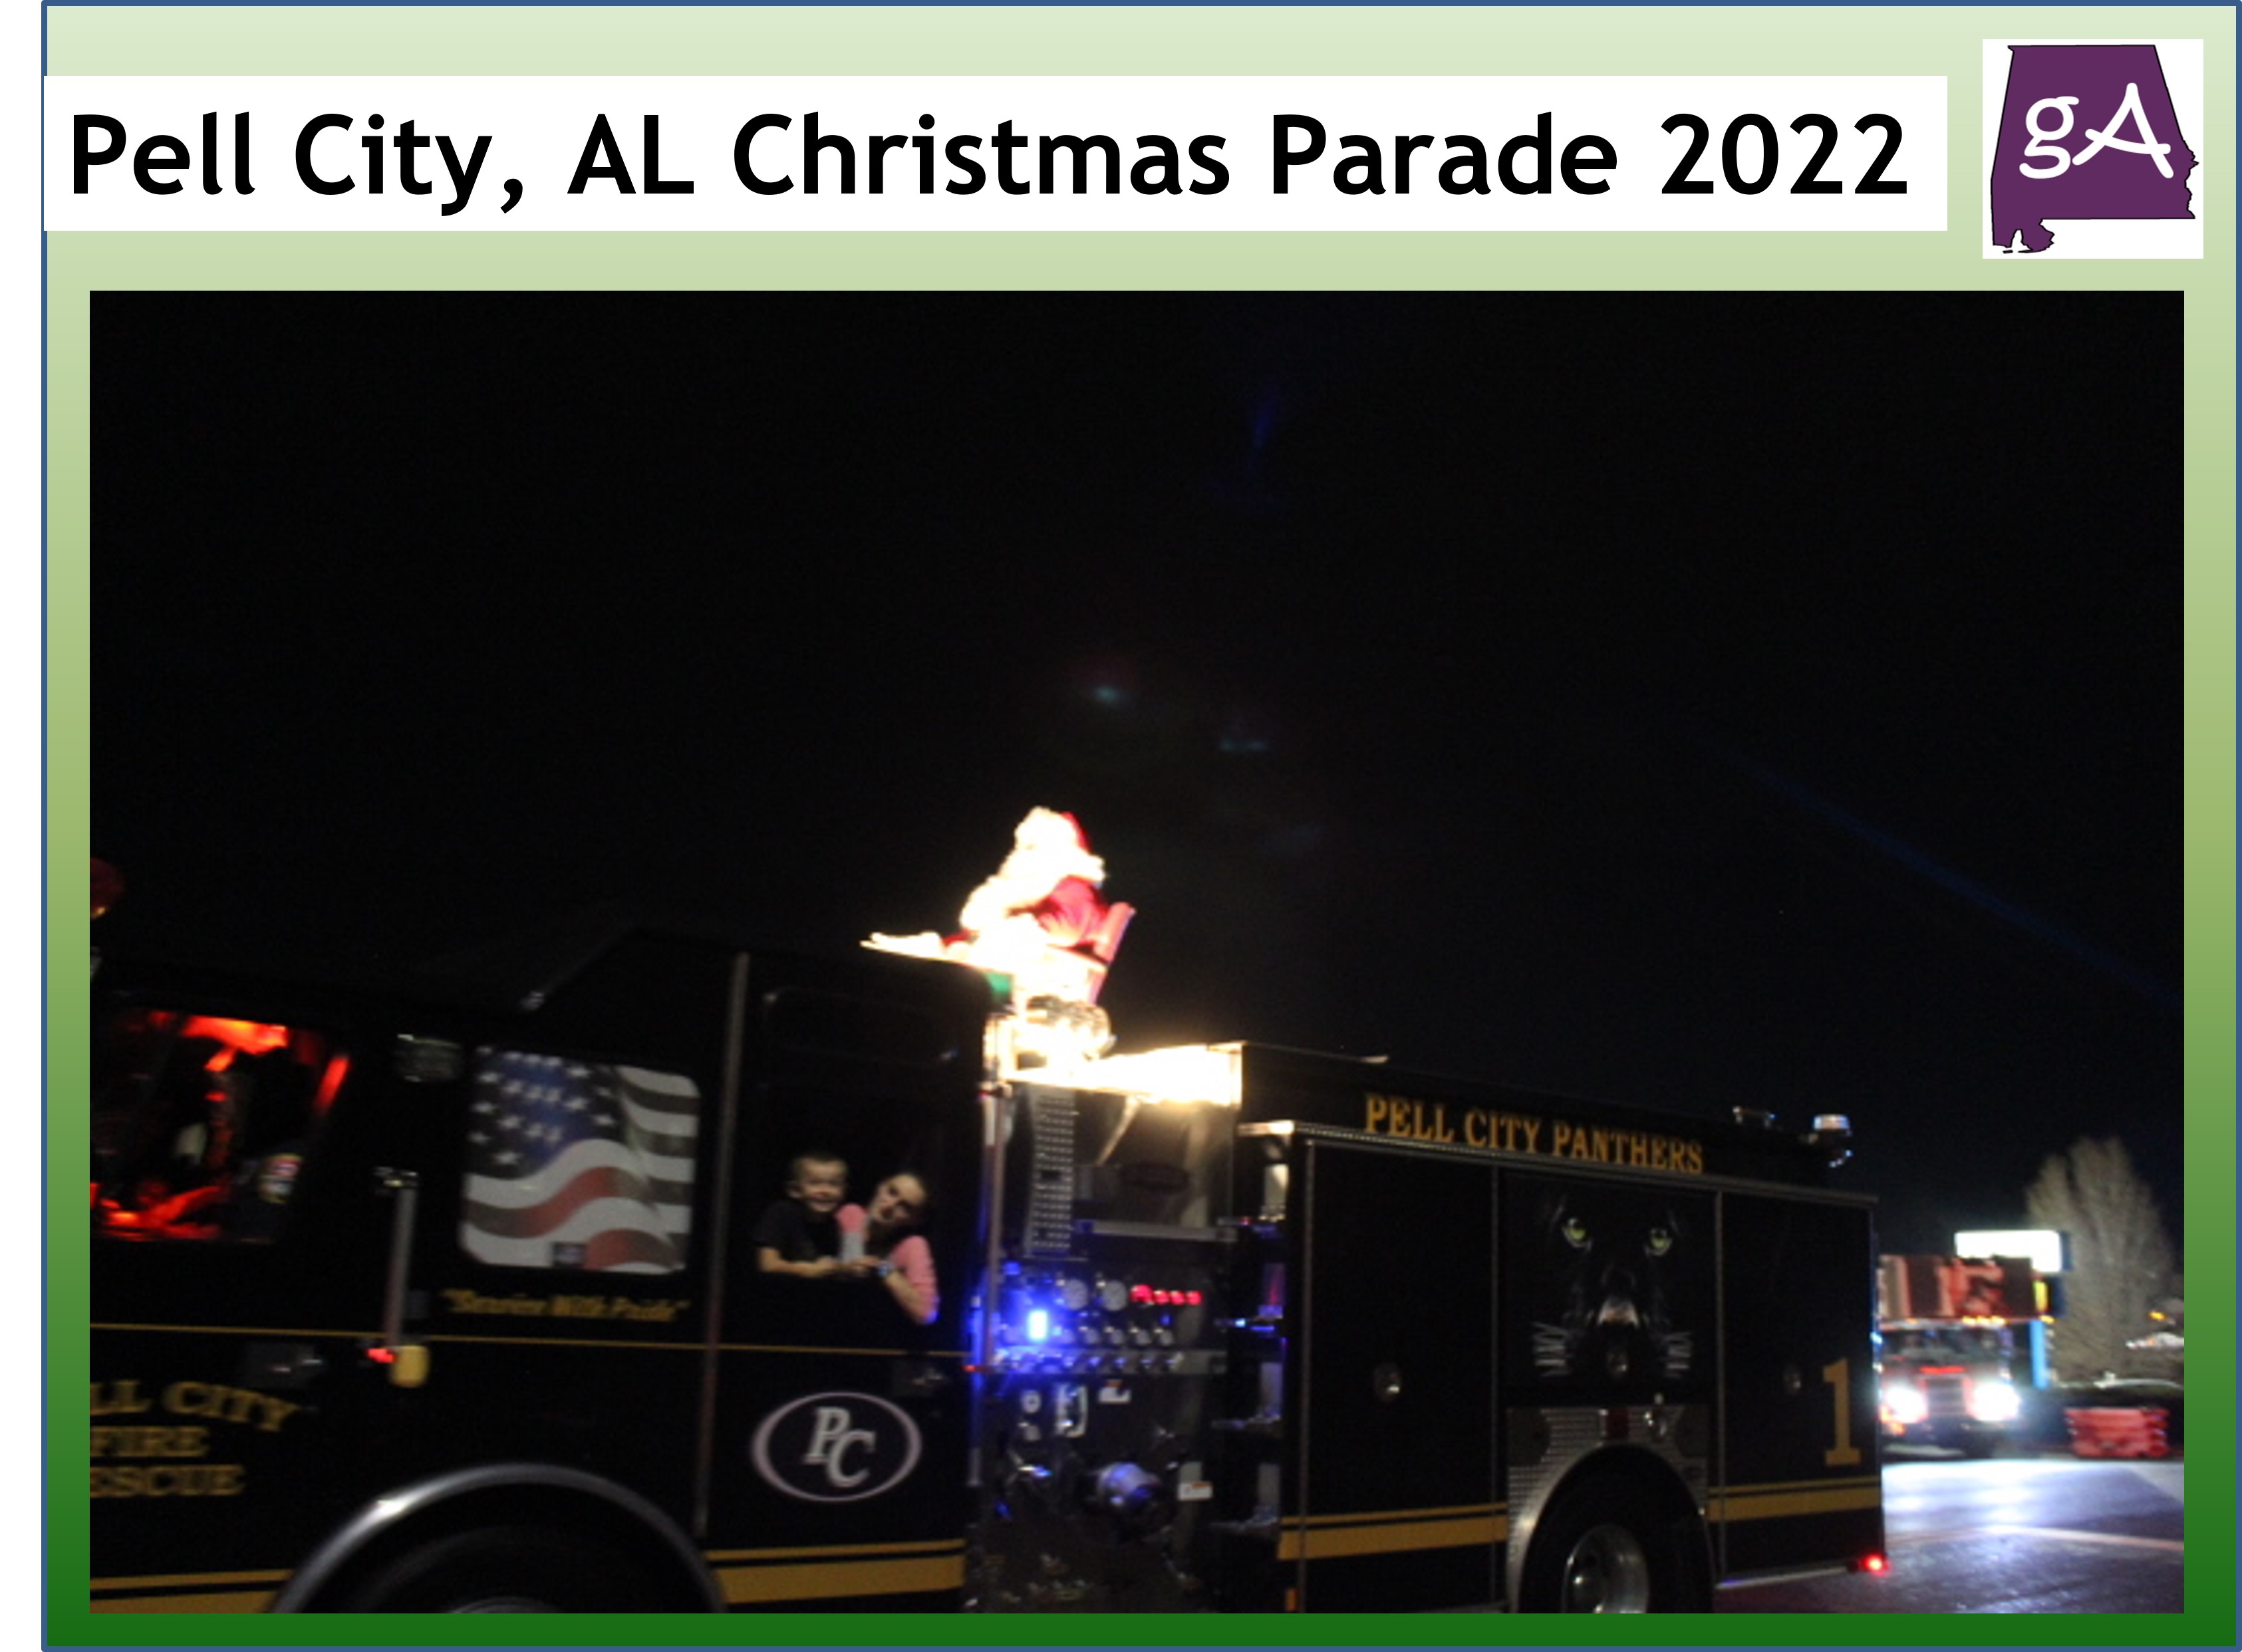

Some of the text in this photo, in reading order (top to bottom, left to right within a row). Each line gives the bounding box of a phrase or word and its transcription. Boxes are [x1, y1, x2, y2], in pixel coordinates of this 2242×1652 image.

[1365, 1092, 1705, 1174] PELL CITY PANTHERS
[164, 1381, 301, 1433] CITY
[801, 1405, 877, 1488] PC
[1822, 1357, 1862, 1468] 1
